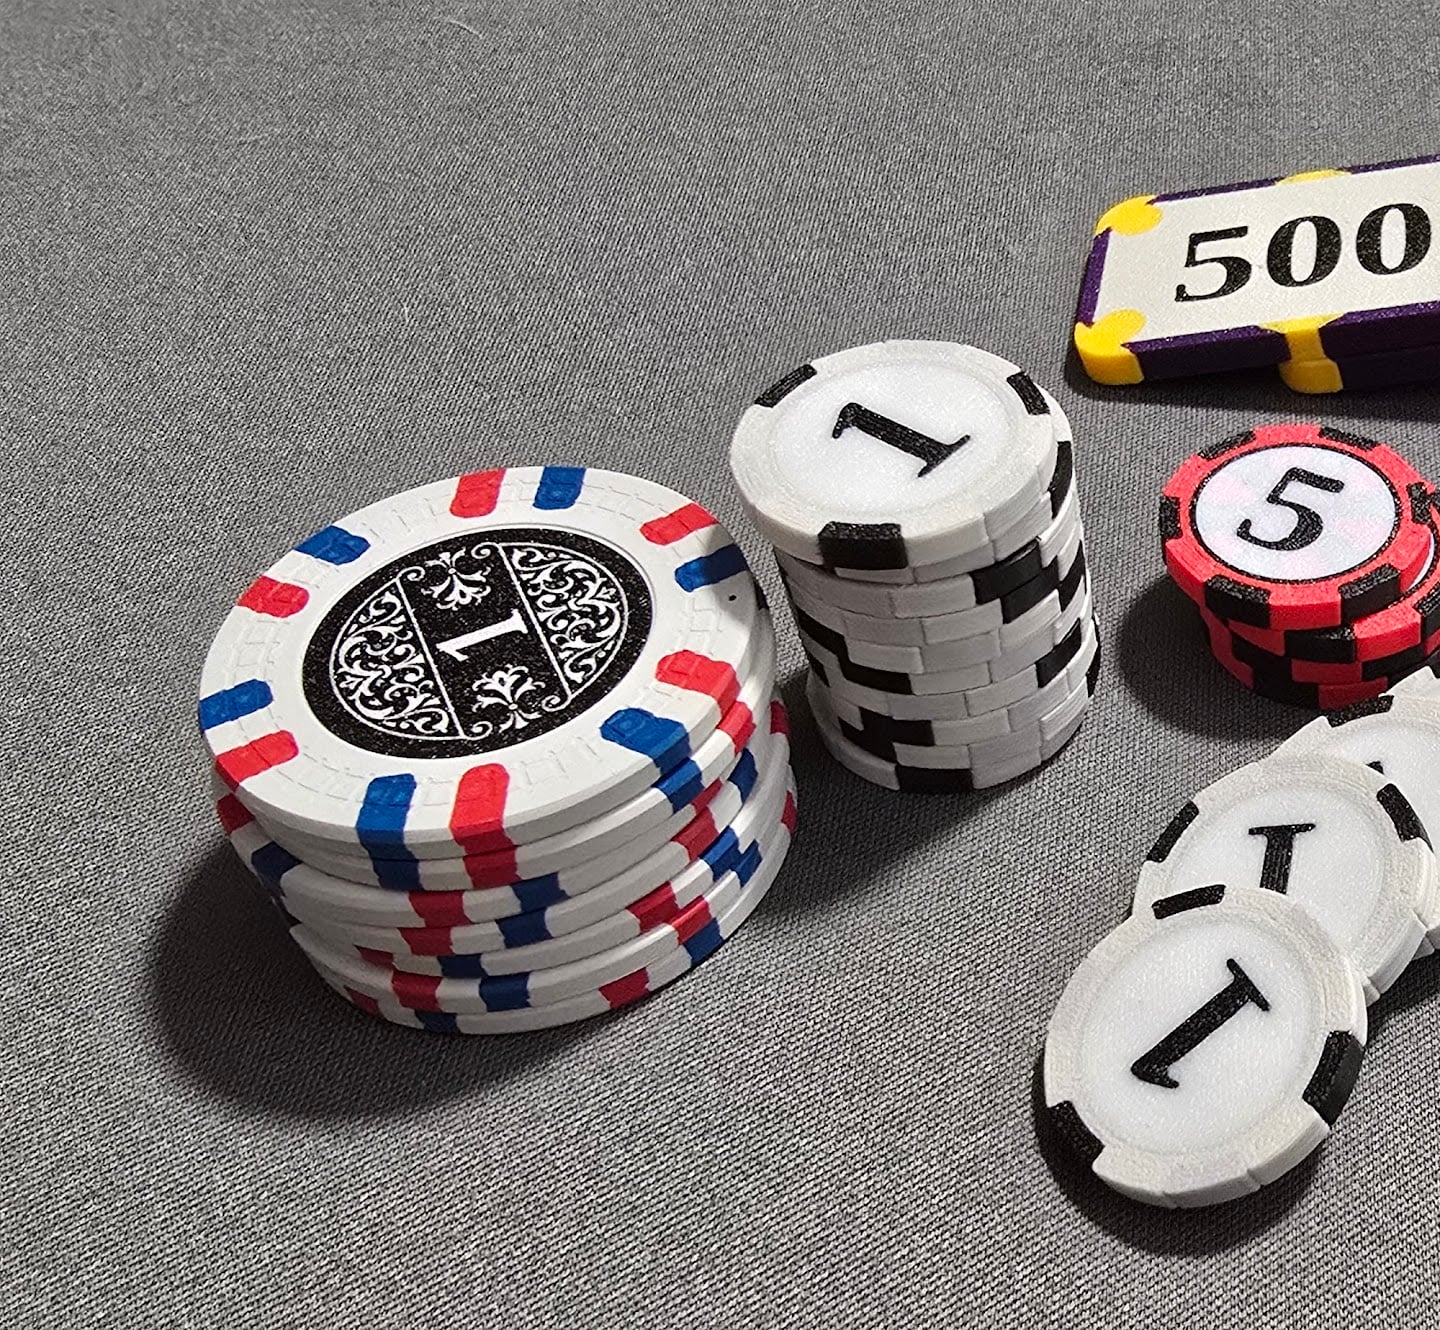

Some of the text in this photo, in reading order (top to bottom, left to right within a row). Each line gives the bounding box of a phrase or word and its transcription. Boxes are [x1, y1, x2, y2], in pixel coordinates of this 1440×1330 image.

[1174, 201, 1432, 303] 500
[832, 402, 970, 477] 1
[1237, 467, 1346, 551] 5
[437, 608, 528, 661] 1
[1130, 958, 1271, 1089] 1
